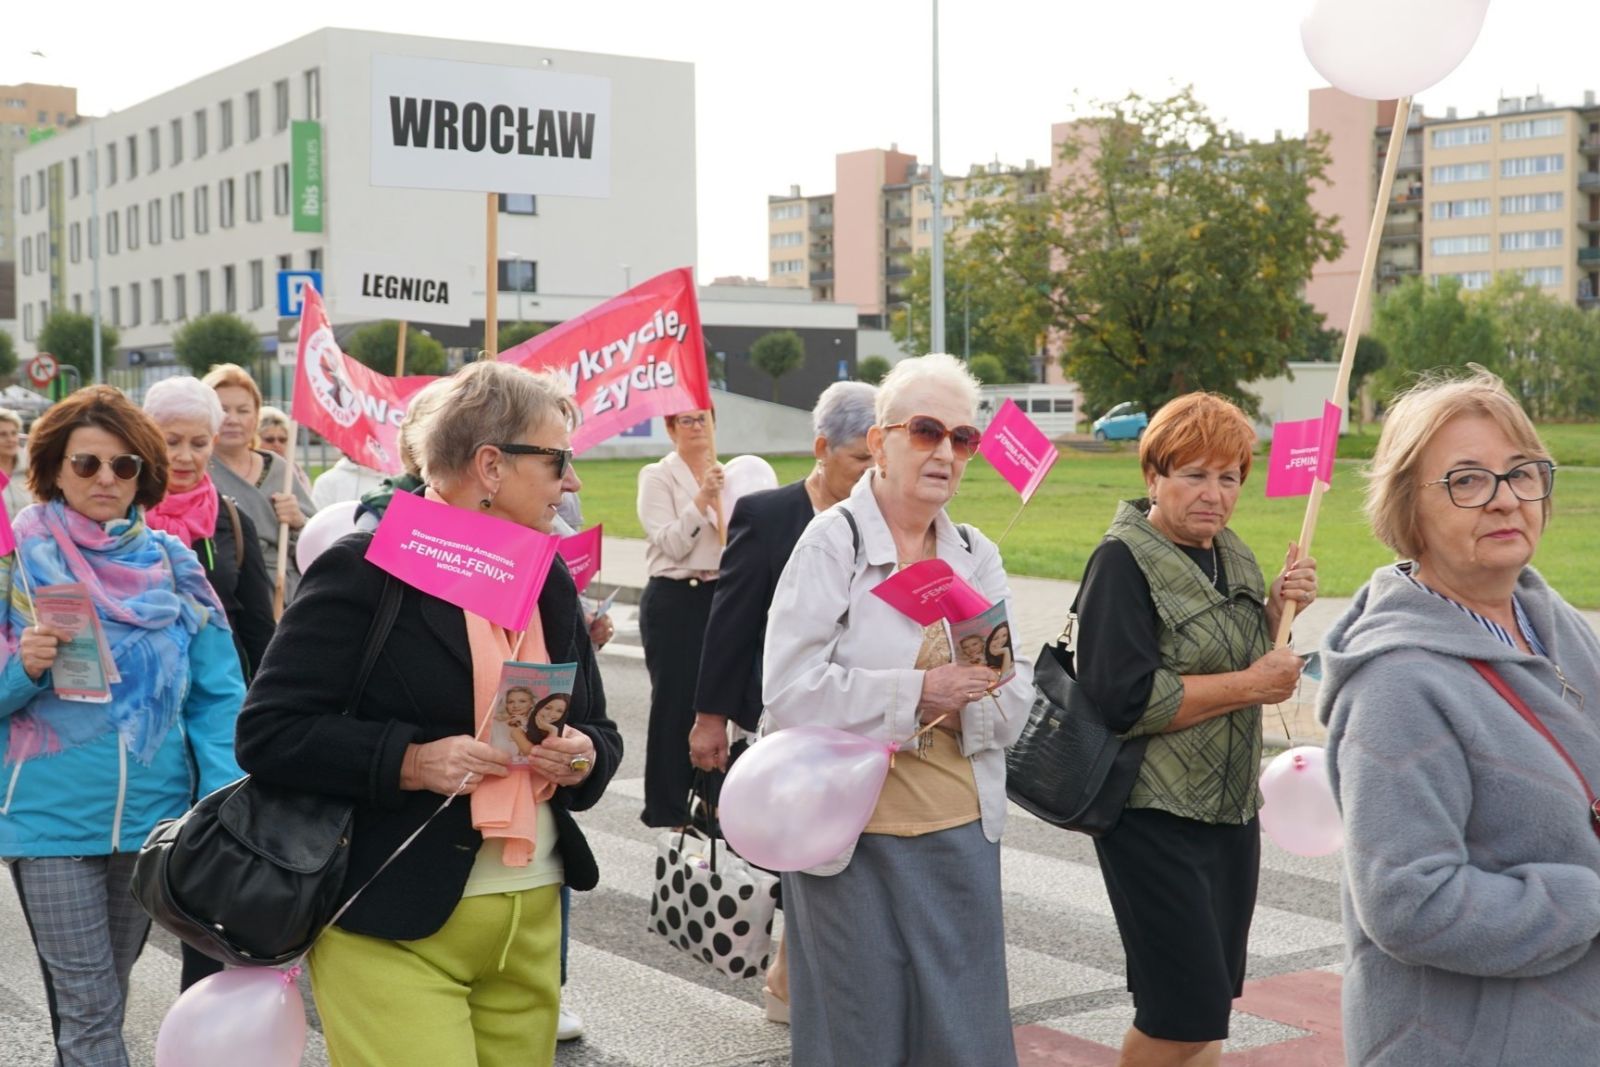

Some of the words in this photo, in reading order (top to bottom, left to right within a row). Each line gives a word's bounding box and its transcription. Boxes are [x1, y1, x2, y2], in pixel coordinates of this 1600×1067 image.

[389, 95, 595, 160] WROCŁAW
[362, 273, 449, 304] LEGNICA
[593, 355, 675, 415] życie
[473, 546, 516, 568] Amazonek
